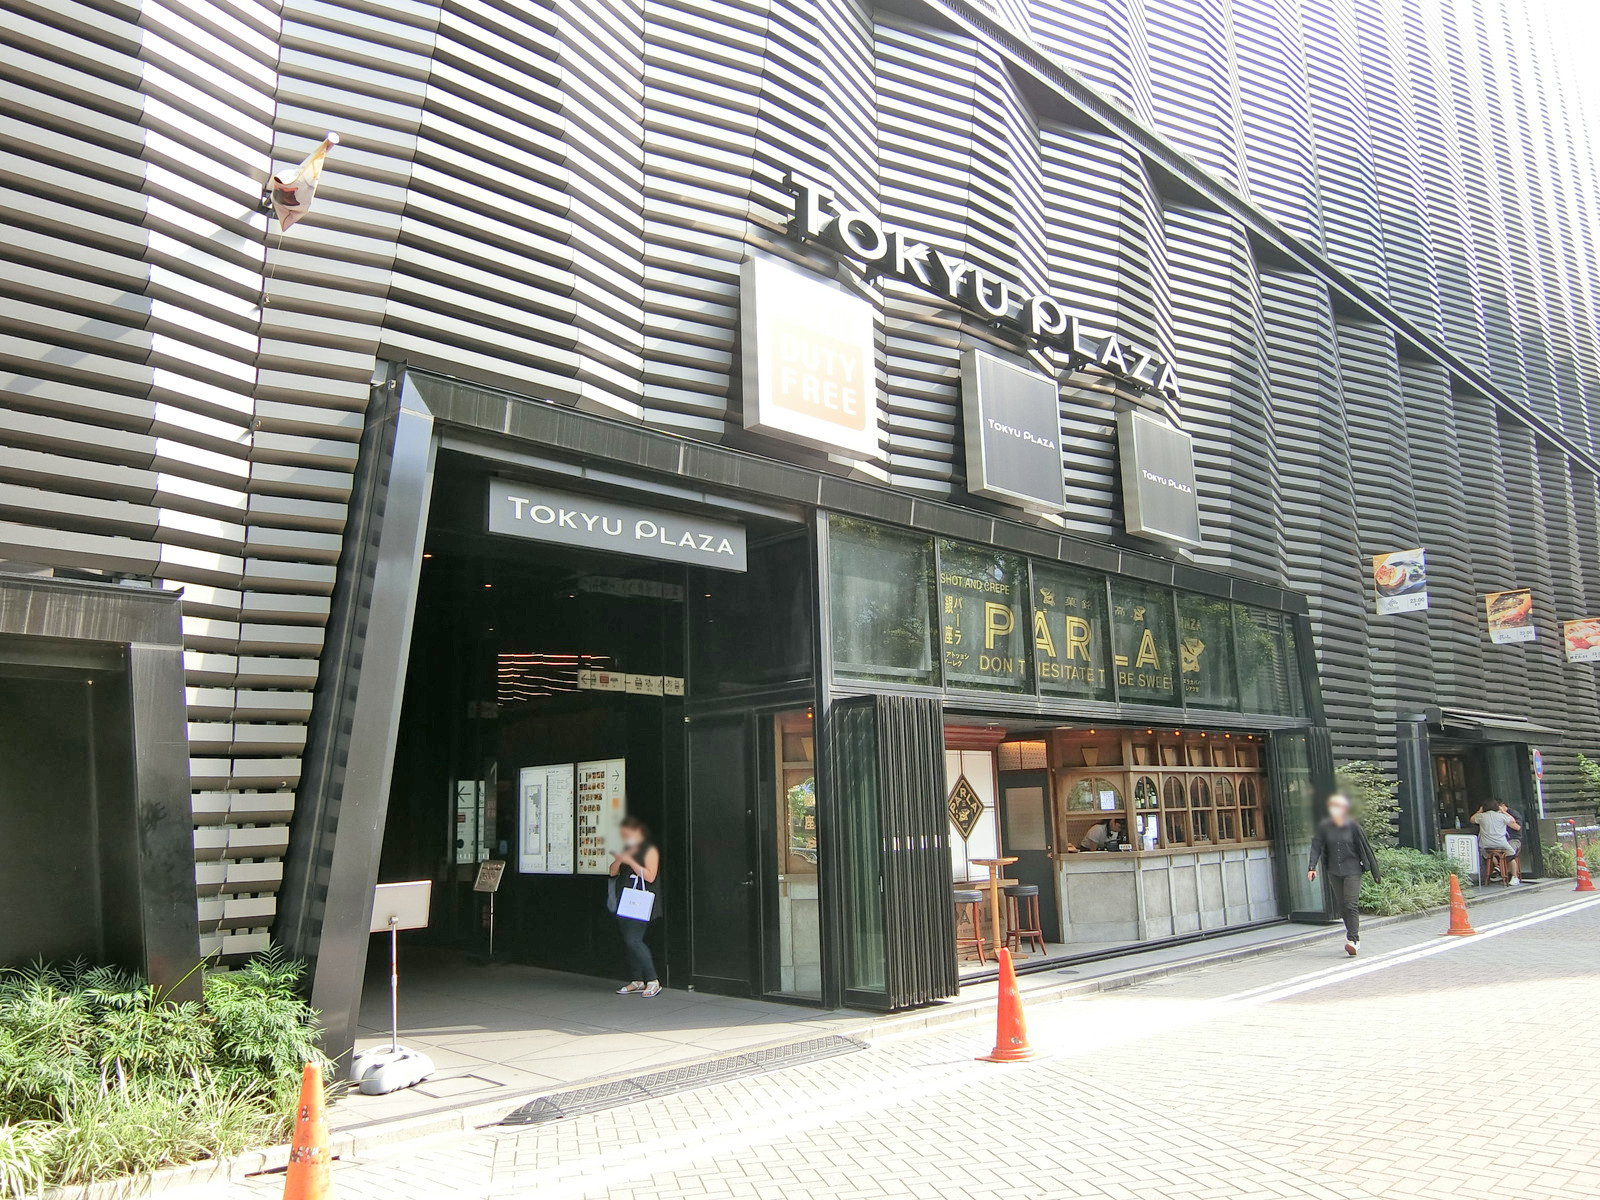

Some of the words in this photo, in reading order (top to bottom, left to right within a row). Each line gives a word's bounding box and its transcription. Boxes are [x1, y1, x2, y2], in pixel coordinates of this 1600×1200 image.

[787, 170, 1009, 317] TOKYU
[1028, 294, 1182, 399] PLAZA
[780, 332, 857, 382] DUTY
[782, 366, 857, 416] FREE
[987, 418, 1021, 438] TOKYU
[1023, 431, 1055, 449] PLAZA
[1142, 469, 1167, 485] TOKYU
[1168, 479, 1191, 494] PLAZA
[507, 496, 623, 536] TOKYU
[635, 520, 734, 556] PLAZA
[940, 573, 963, 586] SHOT
[964, 577, 982, 590] AND
[984, 582, 1010, 595] CREPE
[1119, 671, 1134, 685] BE
[1138, 674, 1174, 690] SWEE
